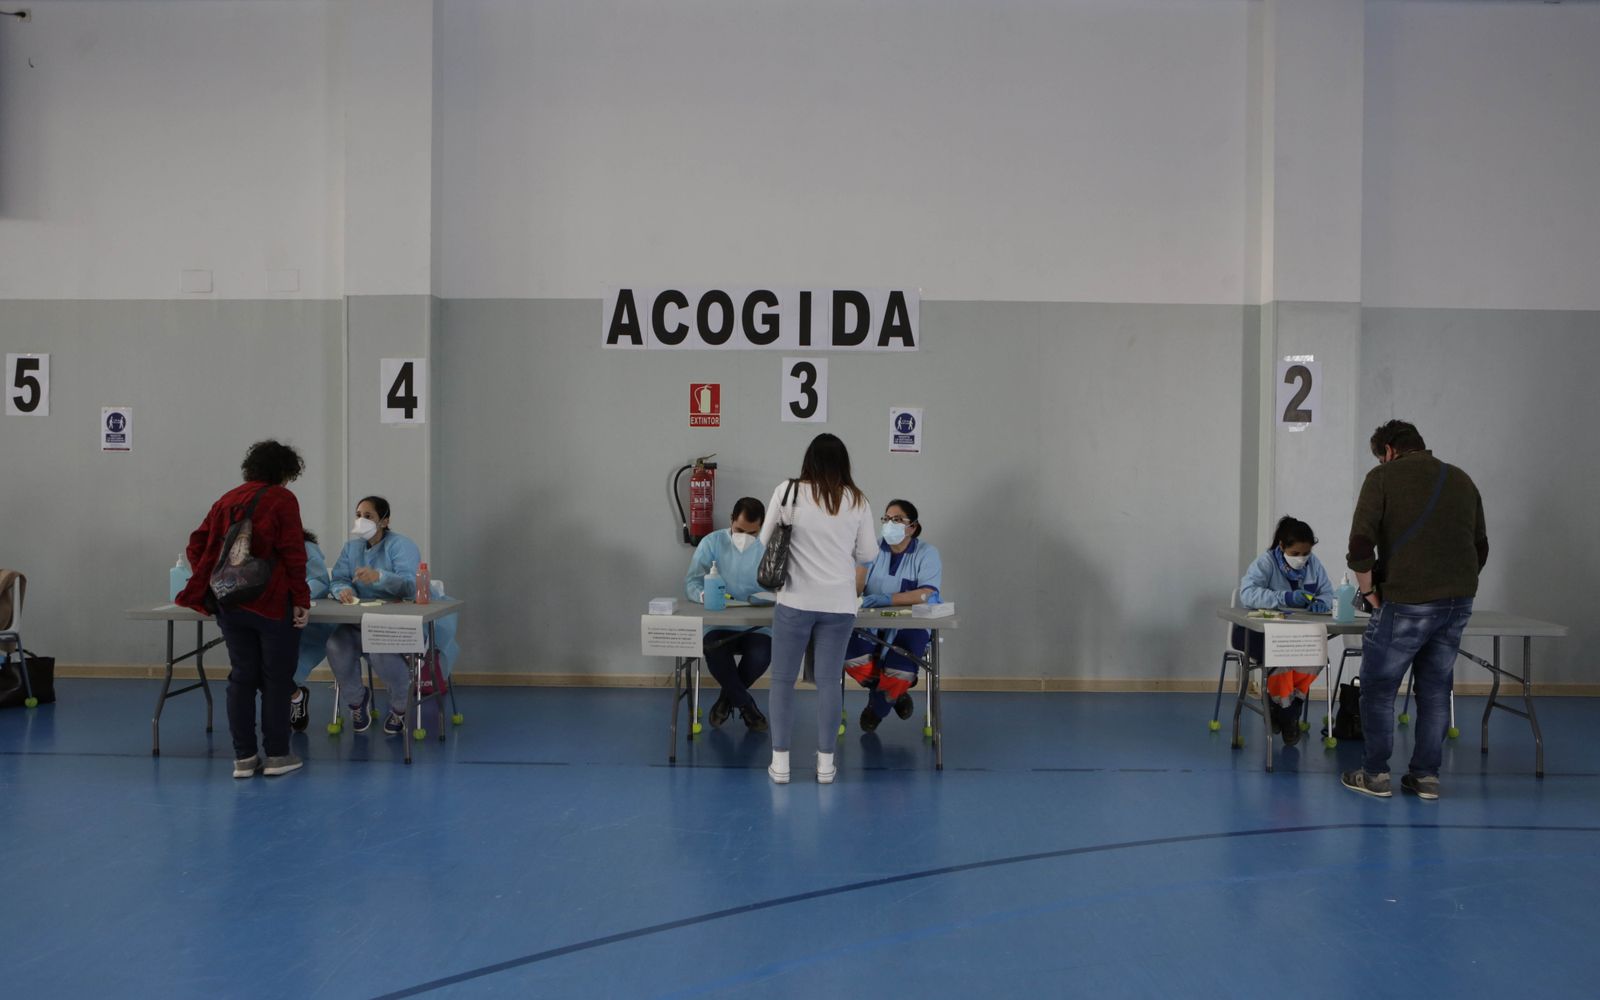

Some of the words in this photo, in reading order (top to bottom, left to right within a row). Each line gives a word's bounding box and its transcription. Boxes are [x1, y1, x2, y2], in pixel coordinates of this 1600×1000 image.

[606, 289, 915, 347] ACOGIDA
[13, 358, 41, 413] 5
[386, 362, 418, 419] 4
[789, 362, 819, 419] 3
[1282, 365, 1313, 423] 2
[690, 416, 720, 425] EXTINTOR
